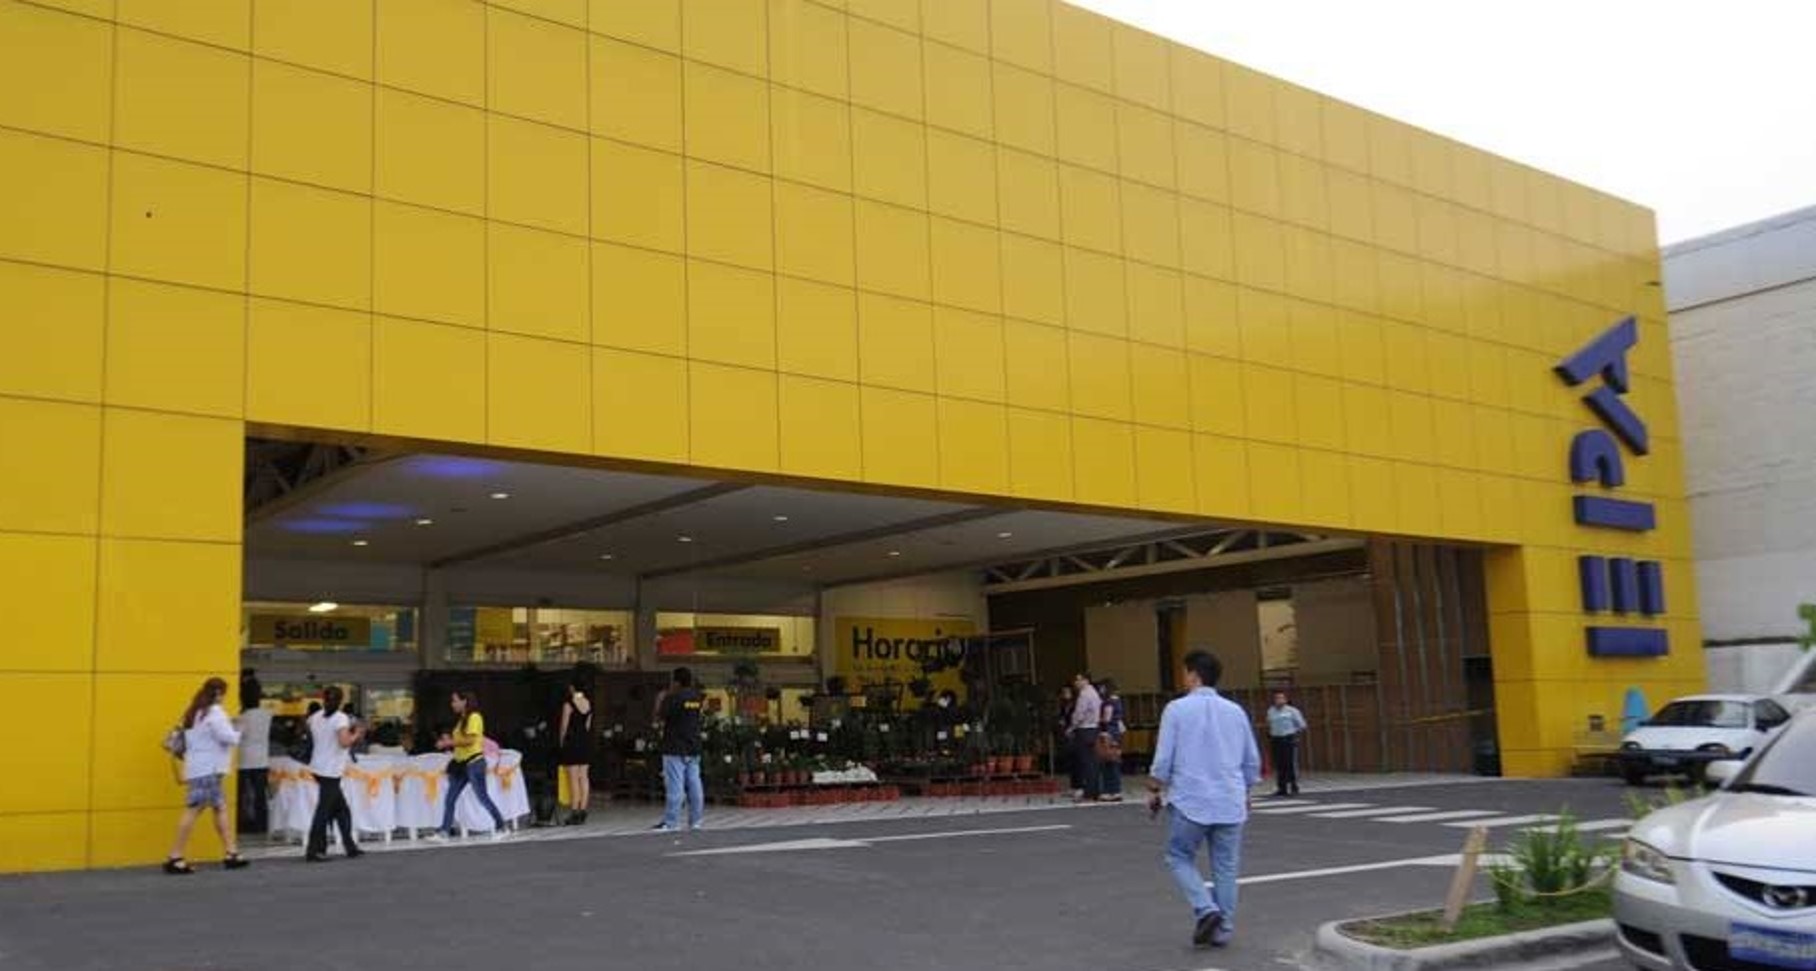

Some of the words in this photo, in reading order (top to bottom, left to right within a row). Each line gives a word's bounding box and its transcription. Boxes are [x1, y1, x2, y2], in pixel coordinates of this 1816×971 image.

[1553, 315, 1670, 658] EPA
[273, 619, 348, 640] Salida
[706, 630, 772, 648] Entrada
